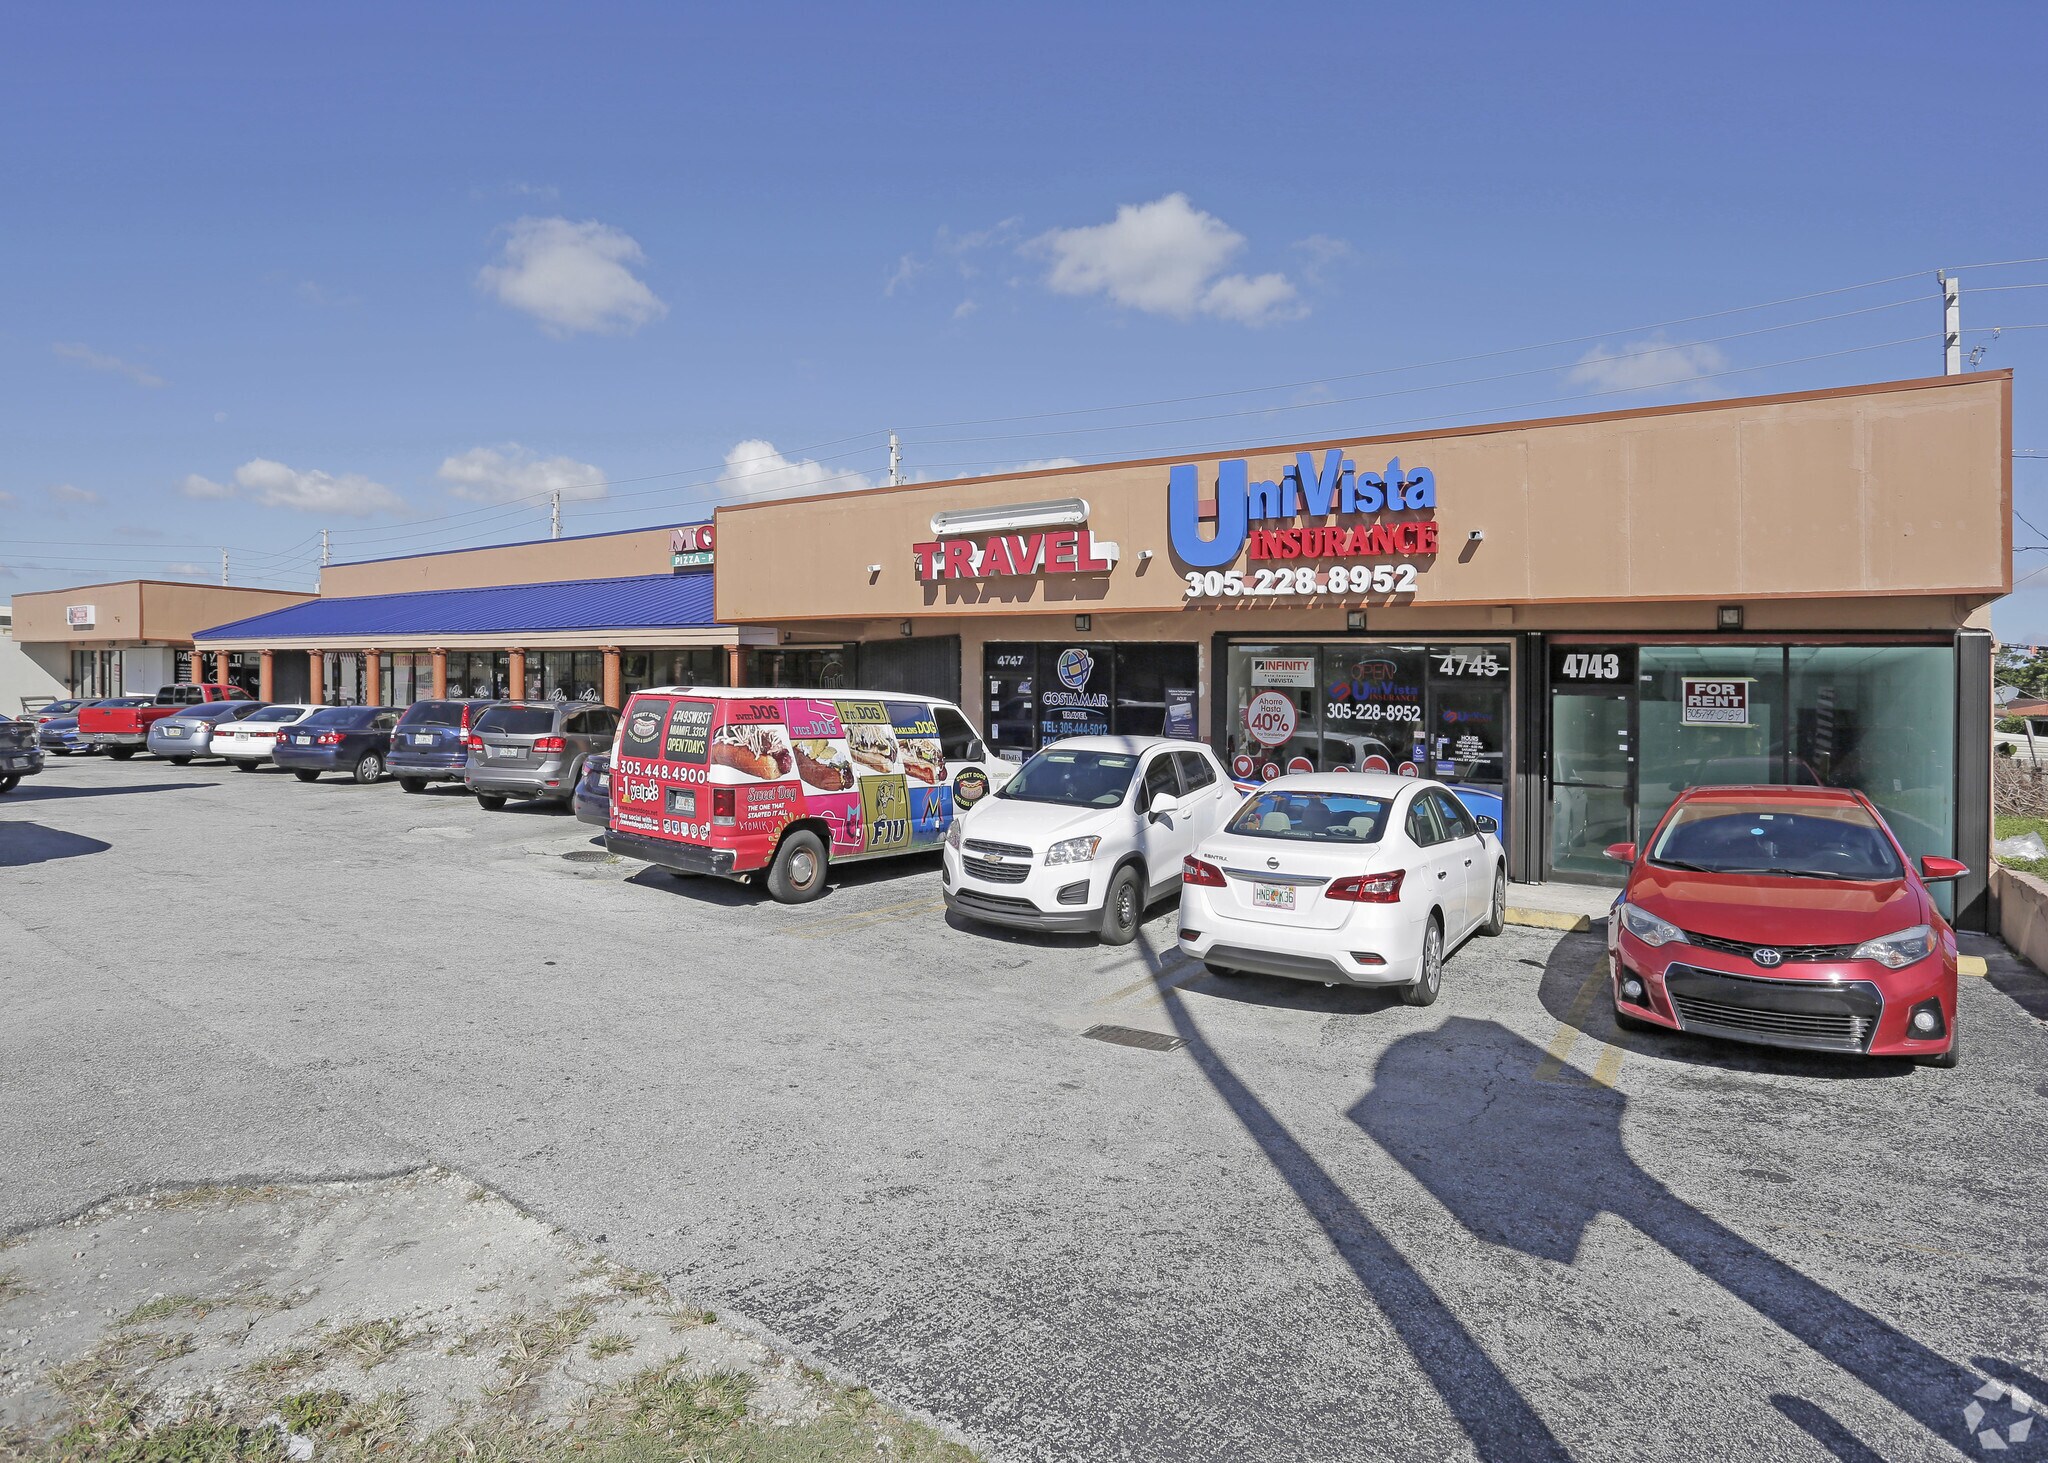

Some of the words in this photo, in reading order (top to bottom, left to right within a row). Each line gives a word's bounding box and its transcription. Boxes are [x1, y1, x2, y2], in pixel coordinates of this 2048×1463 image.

[1170, 449, 1436, 567] UniVista
[1250, 521, 1438, 560] INSURANCE
[675, 555, 700, 565] PIZZA
[913, 529, 1112, 580] TRAVEL
[1184, 564, 1418, 597] 305.228.8952
[997, 655, 1024, 667] 4747
[1265, 660, 1309, 671] INFINITY
[1439, 654, 1499, 677] 4745
[1563, 654, 1619, 679] 4743
[1351, 663, 1394, 680] OPEN
[1694, 684, 1736, 695] FOR
[1042, 691, 1109, 707] COSTAMAR
[1259, 697, 1283, 705] Ahorre
[1368, 694, 1419, 702] INSURANCE
[1688, 695, 1743, 707] RENT
[633, 712, 649, 720] SWEET
[750, 705, 780, 720] DOG
[856, 707, 881, 720] DOG
[1062, 711, 1088, 720] TRAVEL
[1260, 705, 1282, 713] Hasta
[1326, 702, 1421, 722] 305-228-8952
[793, 726, 812, 735] VICE
[810, 720, 837, 735] DOG
[915, 721, 937, 734] DOG
[1042, 721, 1058, 733] TEL:
[1059, 721, 1108, 735] 305-444-5012
[1251, 713, 1290, 732] 40%
[620, 760, 706, 784] 305.448.4900
[956, 772, 973, 782] SWEET
[973, 772, 986, 781] DOGS
[747, 787, 776, 802] Sweet
[776, 785, 797, 802] Dog
[748, 804, 759, 812] THE
[759, 803, 772, 811] ONE
[747, 811, 772, 819] STARTED
[871, 819, 906, 845] FIU
